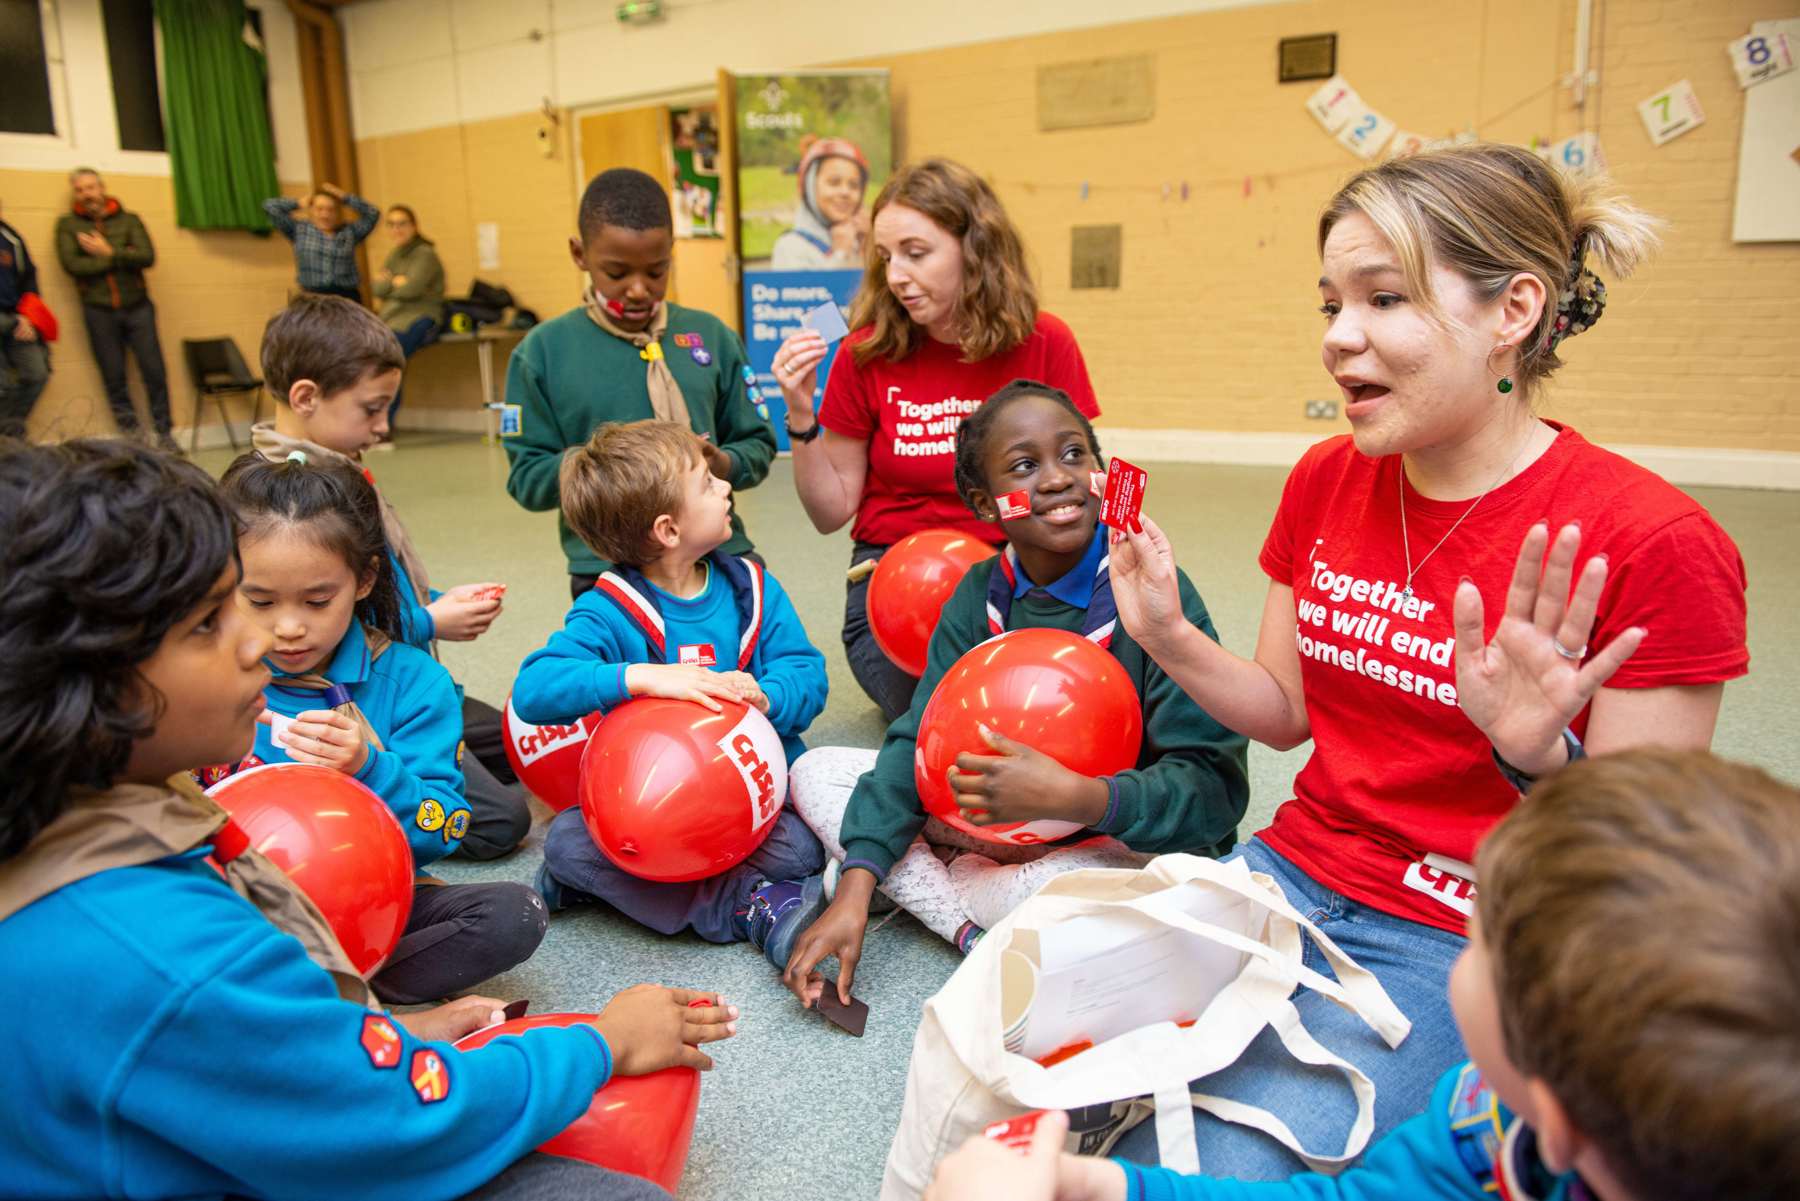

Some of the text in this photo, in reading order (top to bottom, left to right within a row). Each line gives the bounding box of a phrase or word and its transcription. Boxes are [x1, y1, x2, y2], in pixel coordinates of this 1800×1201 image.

[1746, 36, 1771, 65] 8
[745, 111, 804, 129] Scouts
[1651, 94, 1671, 123] 7
[1354, 114, 1378, 141] 2
[1563, 139, 1585, 168] 6
[752, 283, 833, 302] Do more.
[753, 303, 804, 321] Share
[753, 323, 777, 341] Be
[897, 396, 982, 421] Together
[896, 416, 961, 437] we will
[1311, 560, 1436, 623] Together
[1298, 598, 1455, 668] we will end
[1296, 623, 1461, 706] homelessne
[1418, 863, 1476, 900] cri
